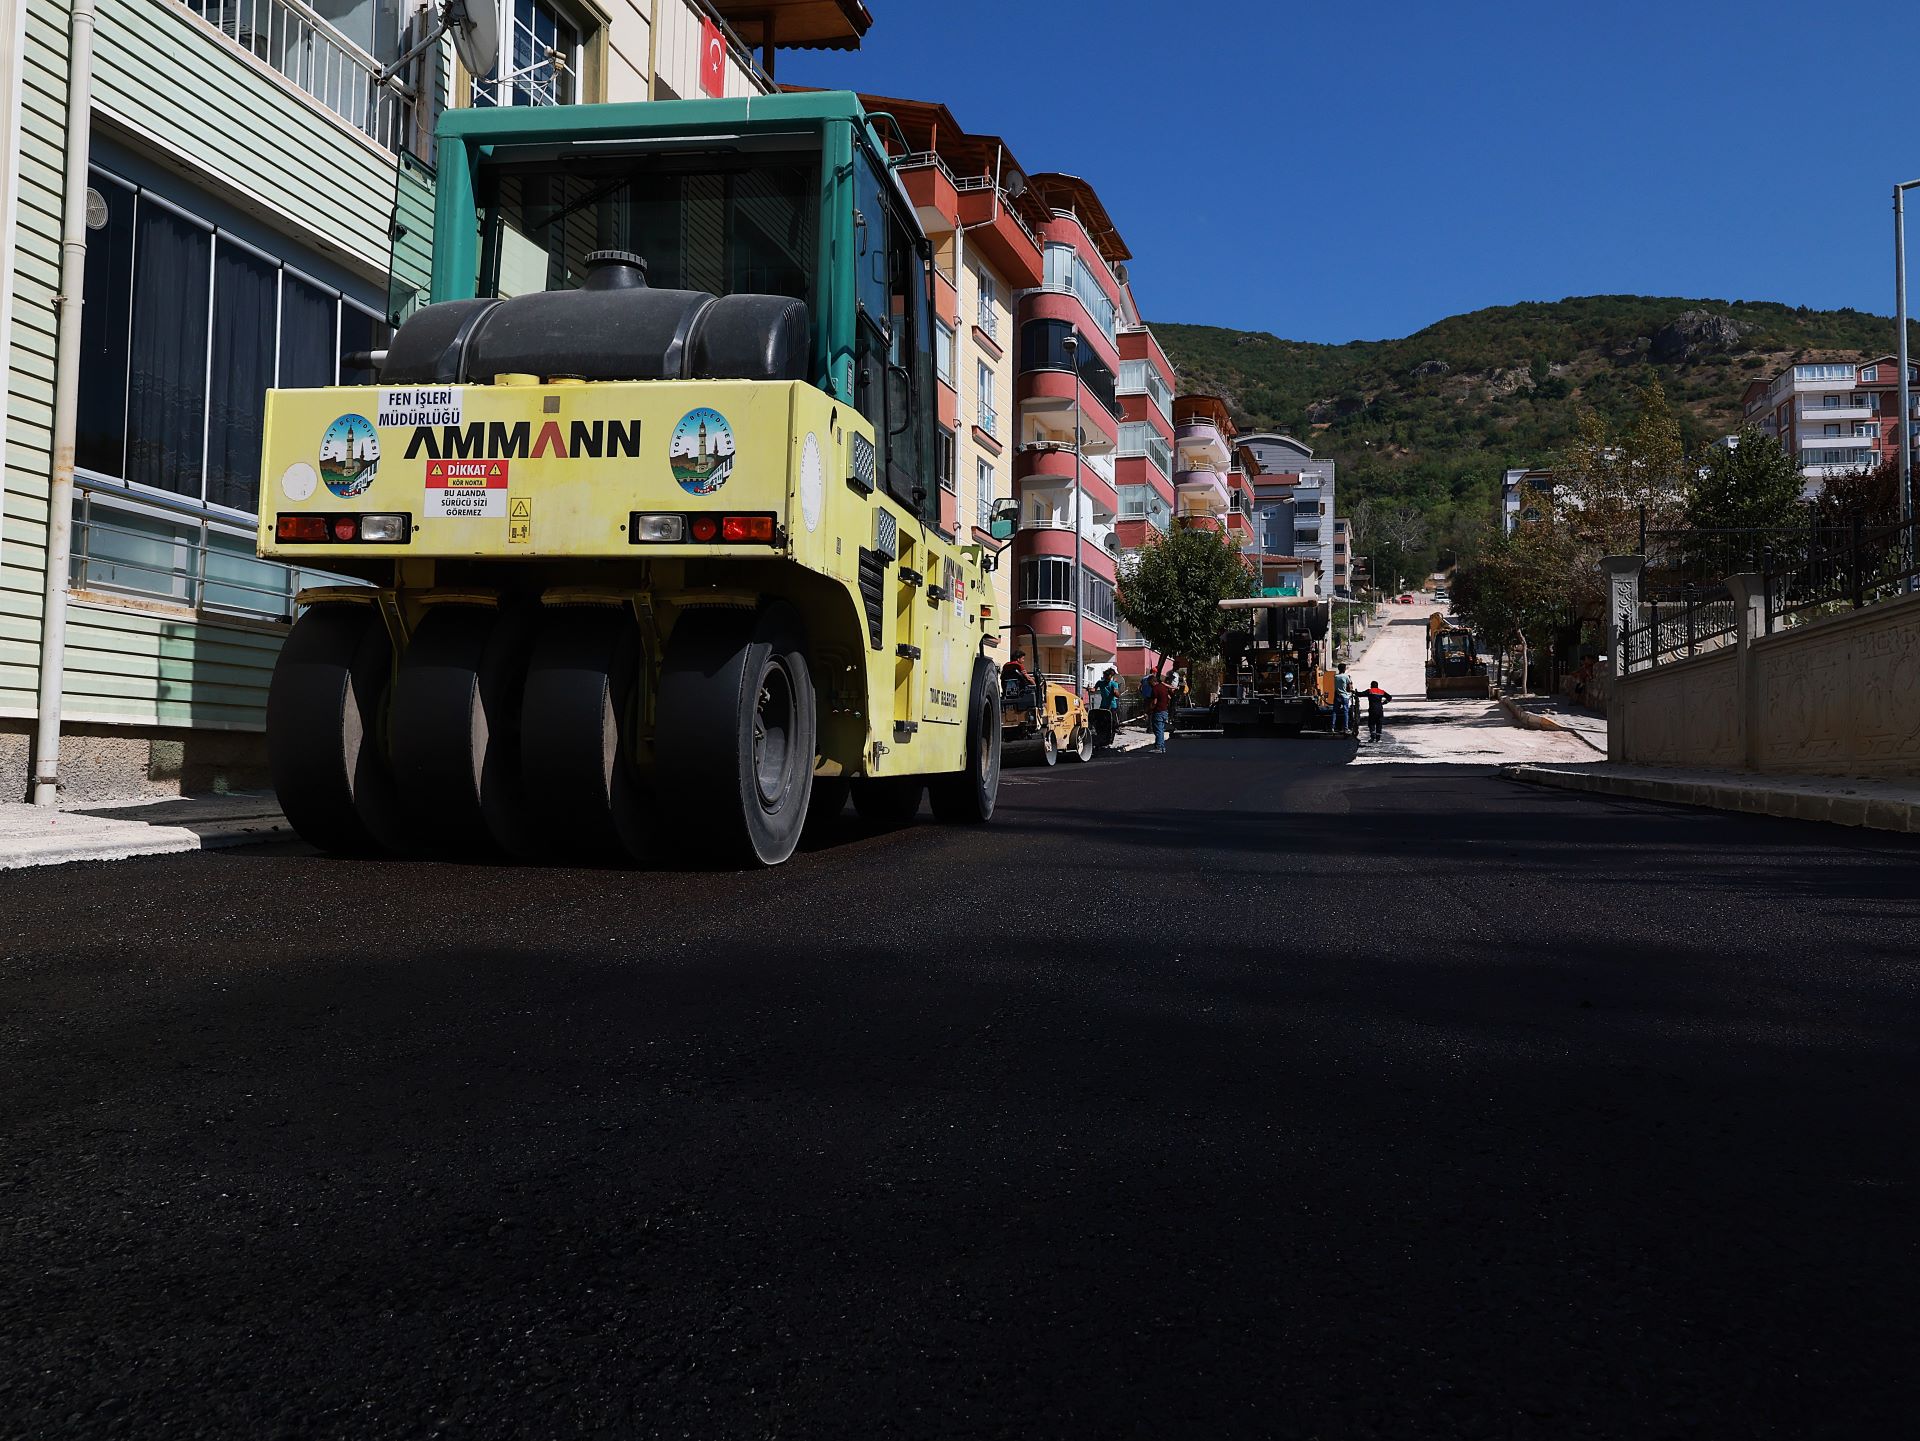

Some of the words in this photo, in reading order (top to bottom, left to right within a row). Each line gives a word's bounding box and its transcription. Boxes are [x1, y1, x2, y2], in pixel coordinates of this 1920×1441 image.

[388, 393, 411, 406] FEN
[415, 388, 452, 409] İŞLERİ
[378, 408, 461, 427] MÜDÜRLÜĞÜ
[323, 427, 337, 457] TOKAT
[403, 419, 642, 459] AMMANN
[673, 422, 688, 454] TOKAT
[447, 461, 487, 476] DİKKAT
[452, 478, 464, 486] KÖR
[444, 489, 455, 497] BU
[456, 489, 486, 497] ALANDA
[441, 497, 472, 507] SÜRÜCÜ
[473, 497, 488, 507] SİZİ
[446, 507, 482, 516] GÖREMEZ
